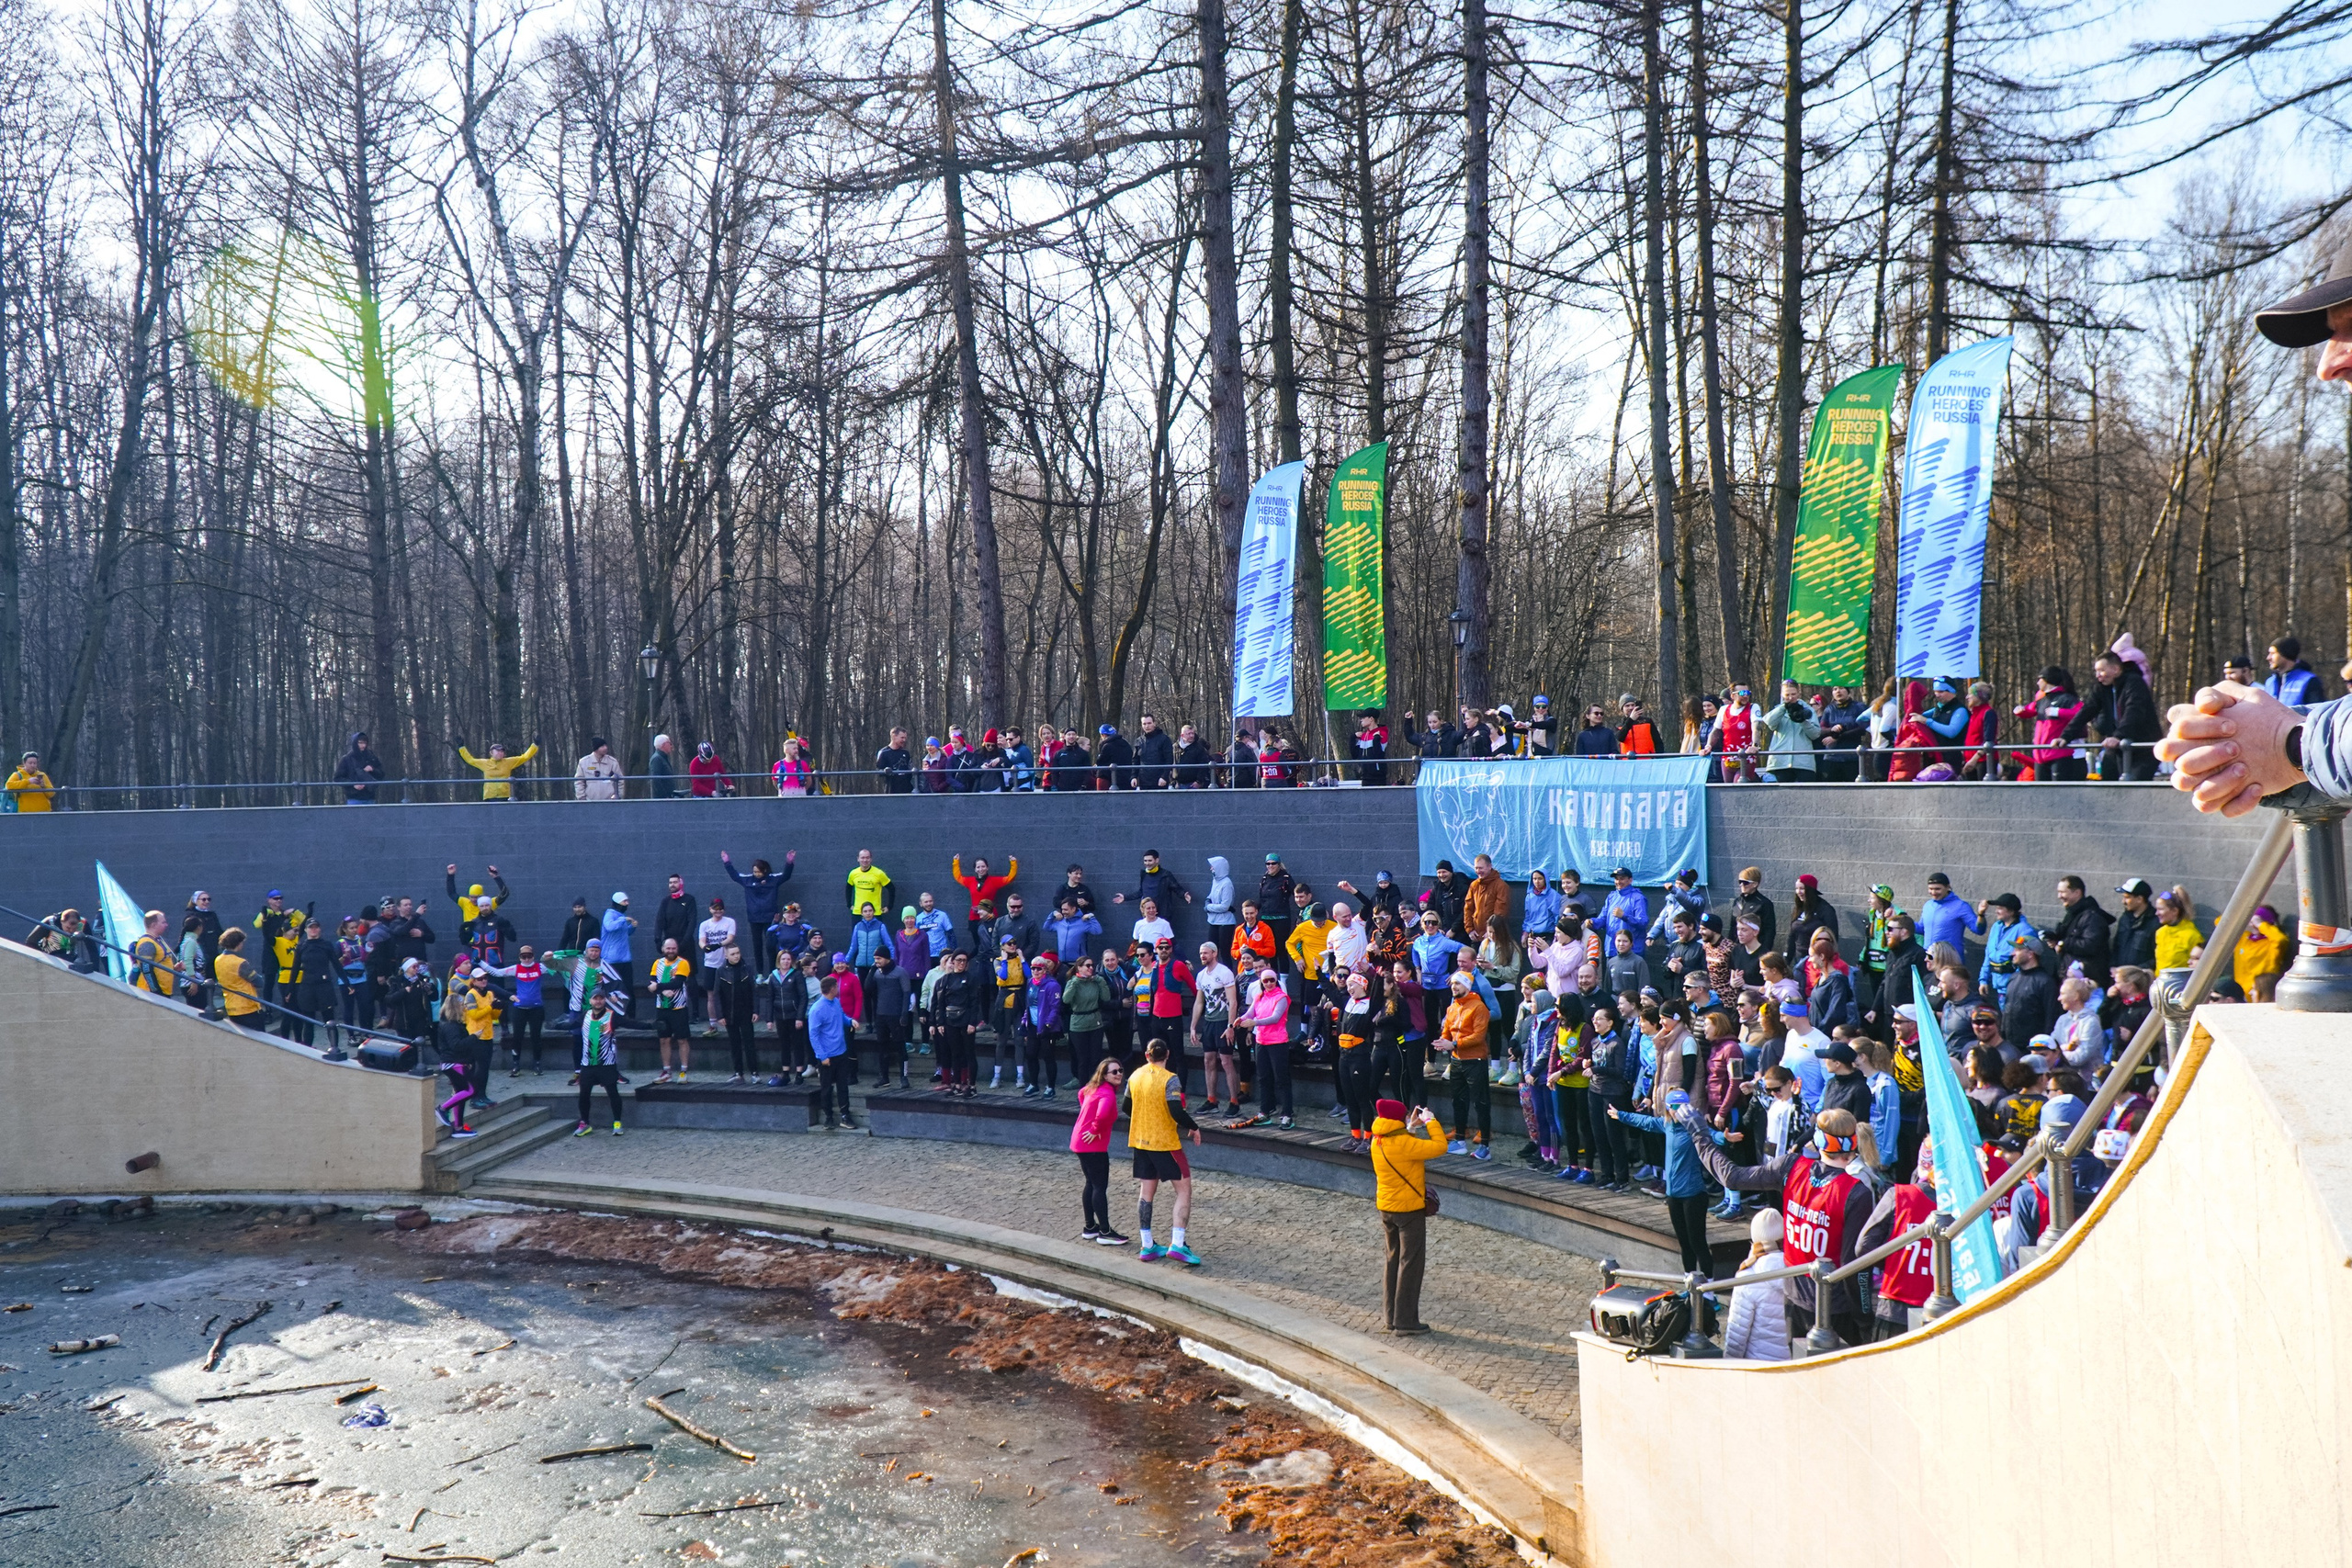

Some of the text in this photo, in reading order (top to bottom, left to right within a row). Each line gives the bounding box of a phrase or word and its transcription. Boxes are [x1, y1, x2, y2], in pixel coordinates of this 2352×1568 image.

[1949, 369, 1976, 378] RHR
[1845, 393, 1871, 402] RHR
[1928, 386, 1991, 399] RUNNING
[1932, 399, 1984, 412] HEROES
[1827, 408, 1885, 422] RUNNING
[1933, 412, 1980, 424] RUSSIA
[1830, 421, 1878, 433] HEROES
[1830, 433, 1873, 446] RUSSIA
[1338, 480, 1379, 491] RUNNING
[1255, 496, 1292, 507] RUNNING
[1341, 491, 1374, 502] HEROES
[1258, 506, 1288, 517] HEROES
[1342, 501, 1373, 512] RUSSIA
[1258, 516, 1286, 526] RUSSIA
[1589, 840, 1642, 858] КУСКОВО
[1786, 1213, 1829, 1258] 5:00
